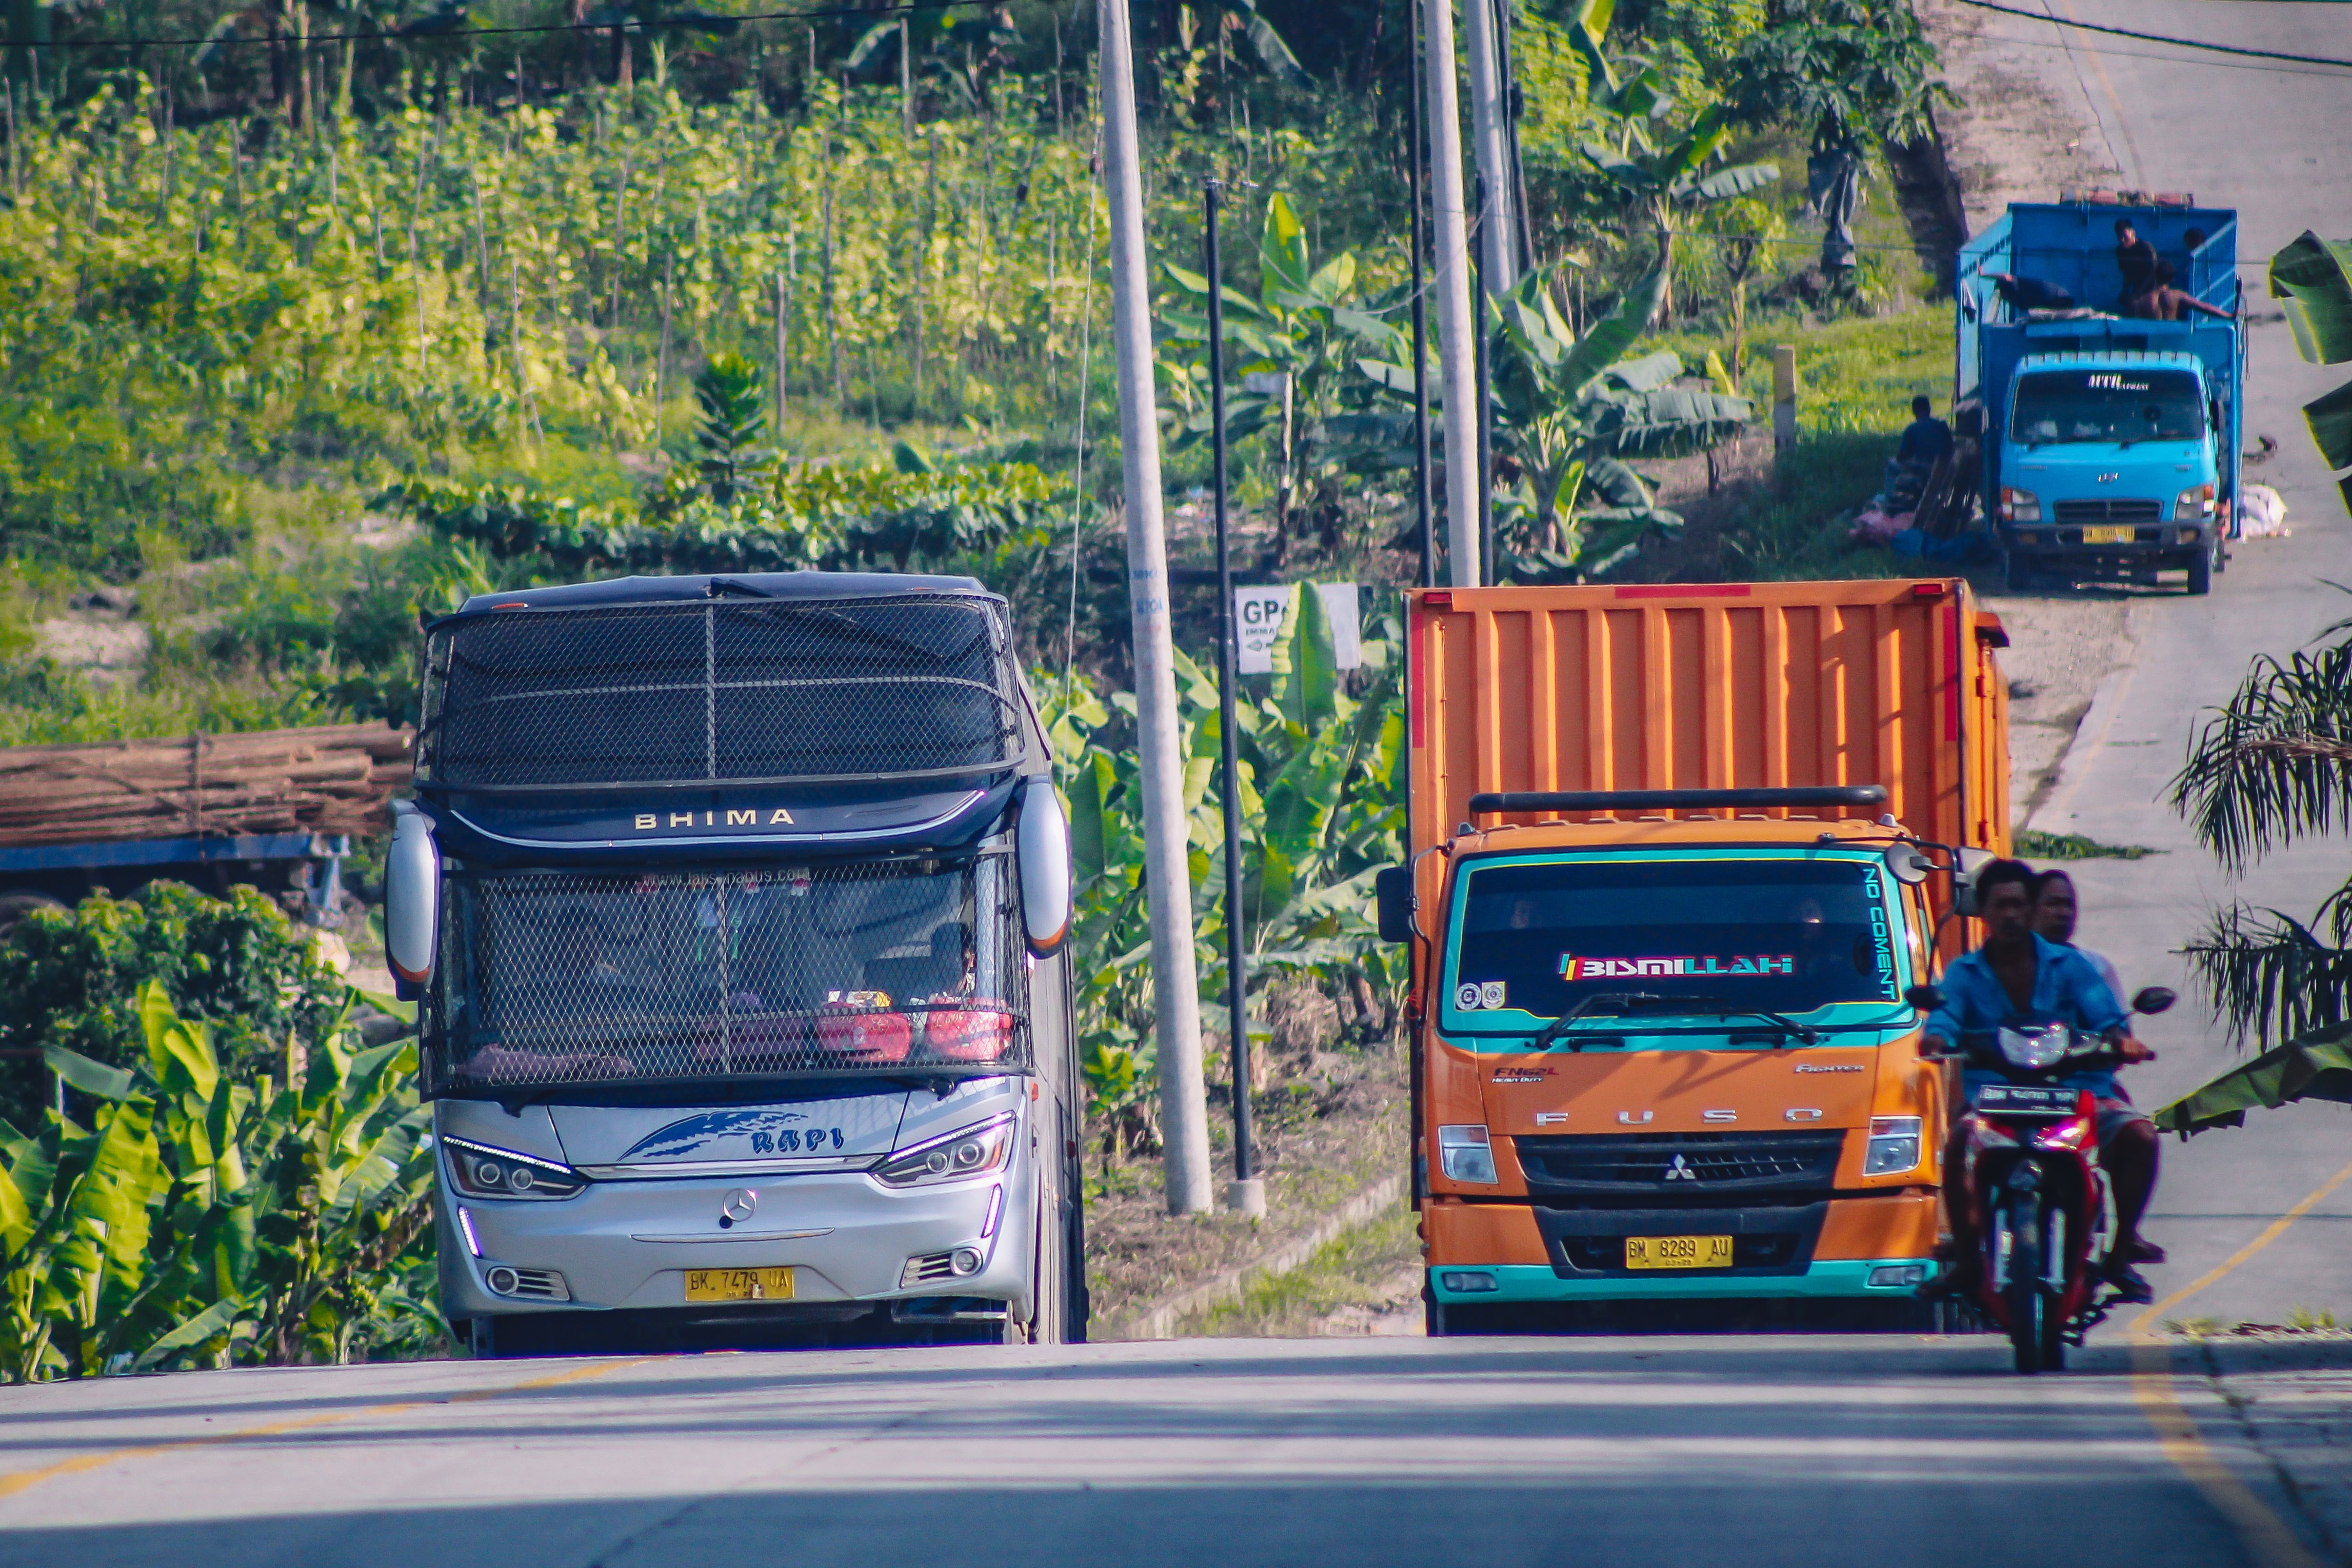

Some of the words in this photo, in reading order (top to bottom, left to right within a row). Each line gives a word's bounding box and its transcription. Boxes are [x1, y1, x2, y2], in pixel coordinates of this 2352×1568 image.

[635, 808, 794, 830] BHIMA
[1863, 868, 1881, 899] NO
[1870, 906, 1896, 1000] COMENT
[1582, 957, 1793, 977] BISMILLAH
[1537, 1108, 1823, 1127] FUSO
[750, 1127, 845, 1154] RAPI
[1626, 1239, 1646, 1258] BM
[1660, 1239, 1696, 1257] 8289
[1712, 1238, 1728, 1256] AU
[690, 1272, 709, 1291] BK
[721, 1271, 759, 1289] 7479
[770, 1270, 789, 1288] UA
